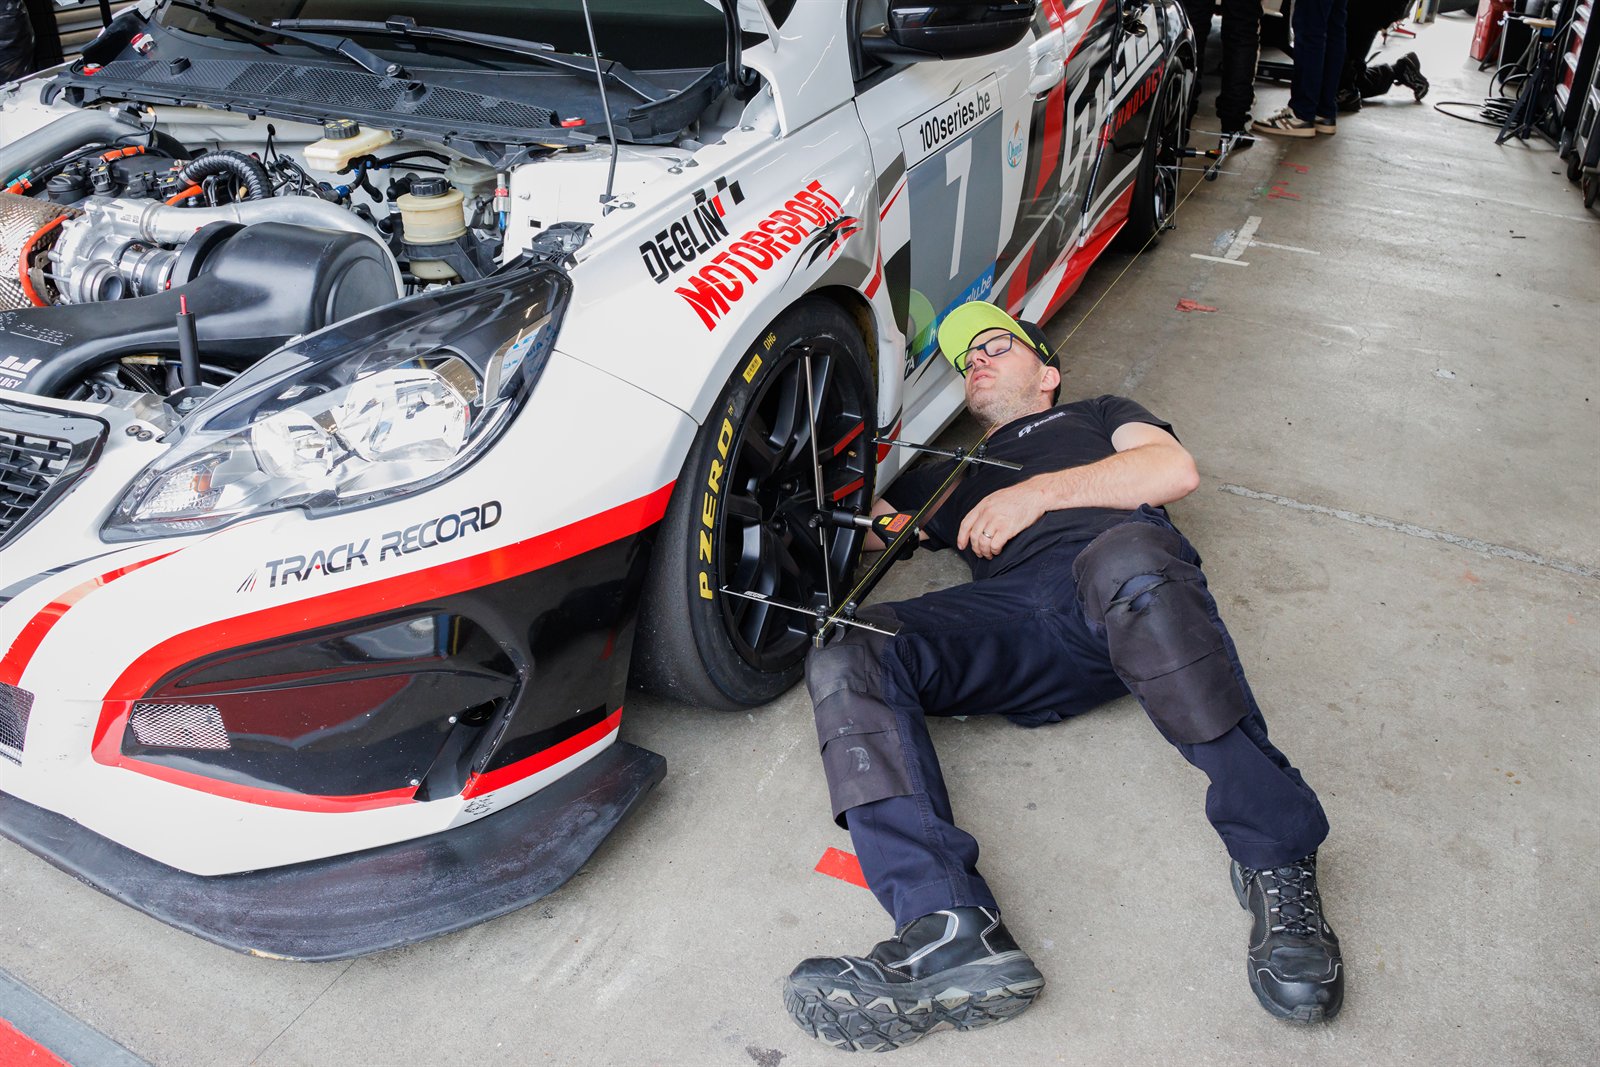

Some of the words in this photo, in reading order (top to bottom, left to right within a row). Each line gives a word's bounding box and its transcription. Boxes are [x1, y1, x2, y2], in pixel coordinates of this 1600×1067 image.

[919, 91, 991, 152] 100series.be
[639, 199, 729, 284] DEGLIN
[945, 137, 972, 280] 7
[674, 179, 845, 332] MOTORSPORT
[700, 418, 734, 564] ZERO
[265, 537, 371, 588] TRACK
[379, 500, 502, 562] RECORD
[699, 571, 713, 600] P
